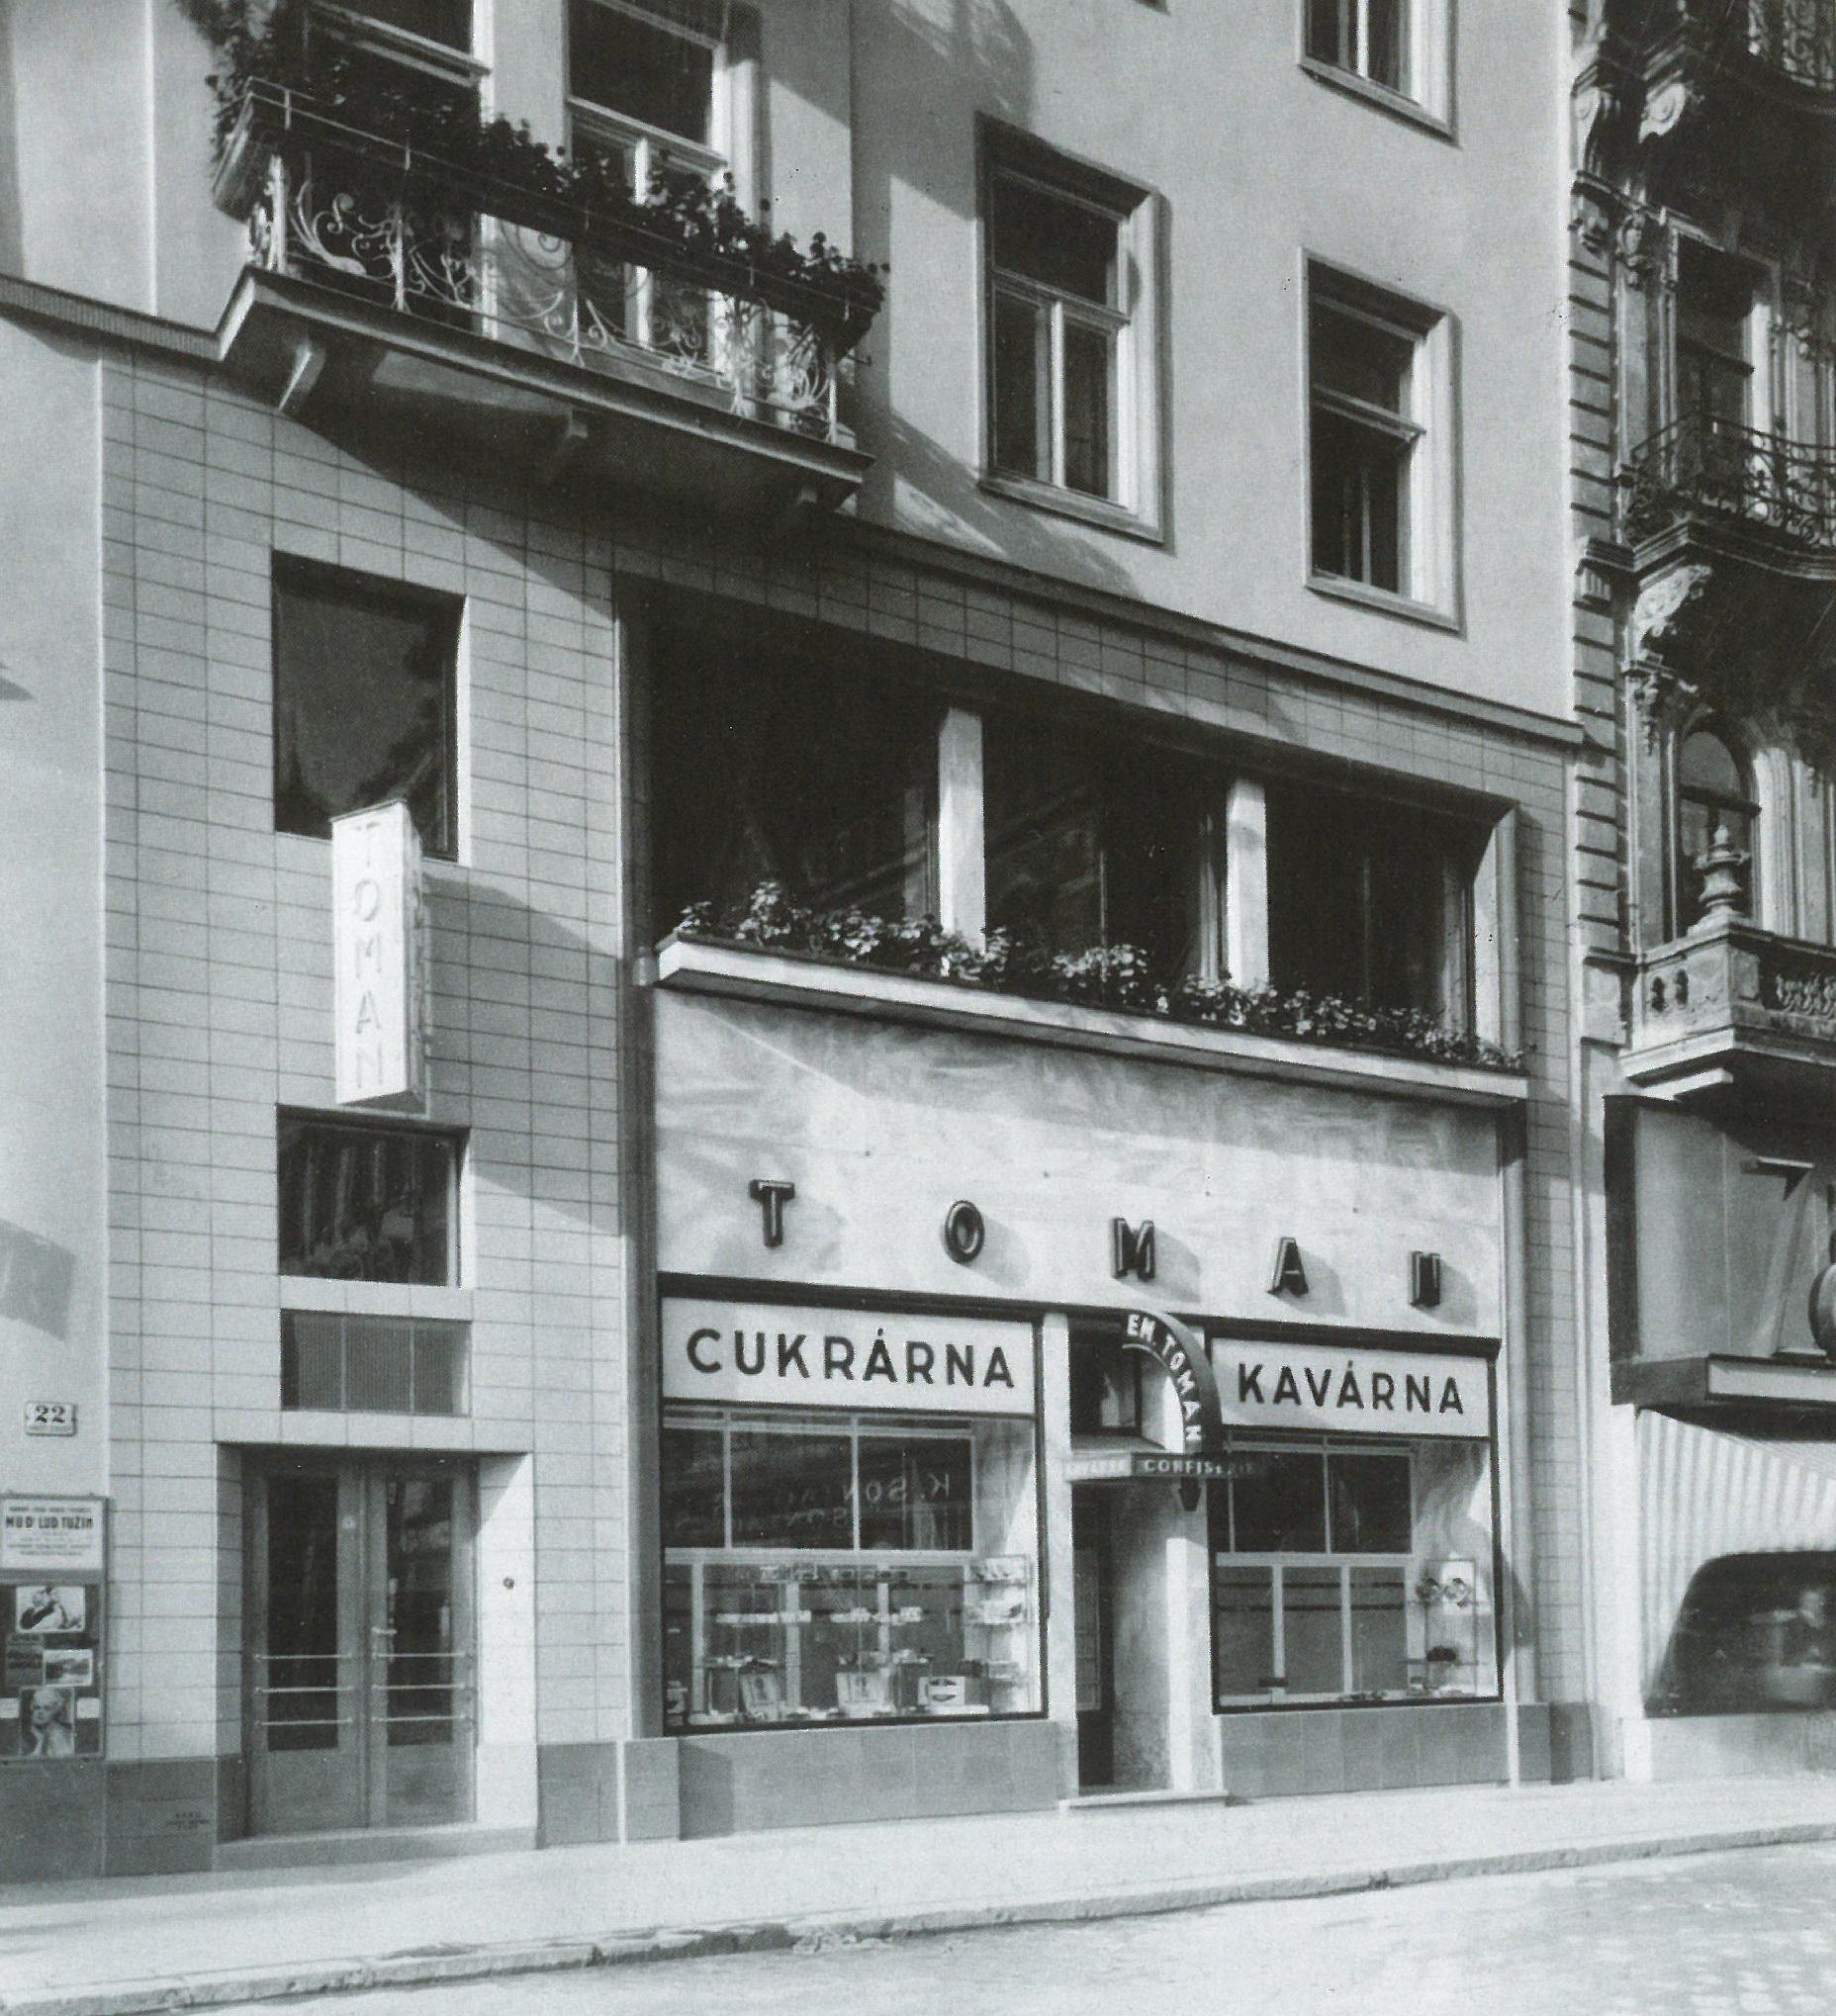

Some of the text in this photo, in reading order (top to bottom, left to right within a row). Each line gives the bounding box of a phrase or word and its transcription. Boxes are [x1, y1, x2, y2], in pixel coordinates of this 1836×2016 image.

[352, 821, 383, 1089] TOMAN
[748, 1177, 1441, 1307] TOMAN
[687, 1327, 1015, 1389] CUKRÁRNA
[1161, 1333, 1204, 1441] TOMAN
[1238, 1360, 1465, 1415] KAVÁRNA
[35, 1403, 66, 1423] 22
